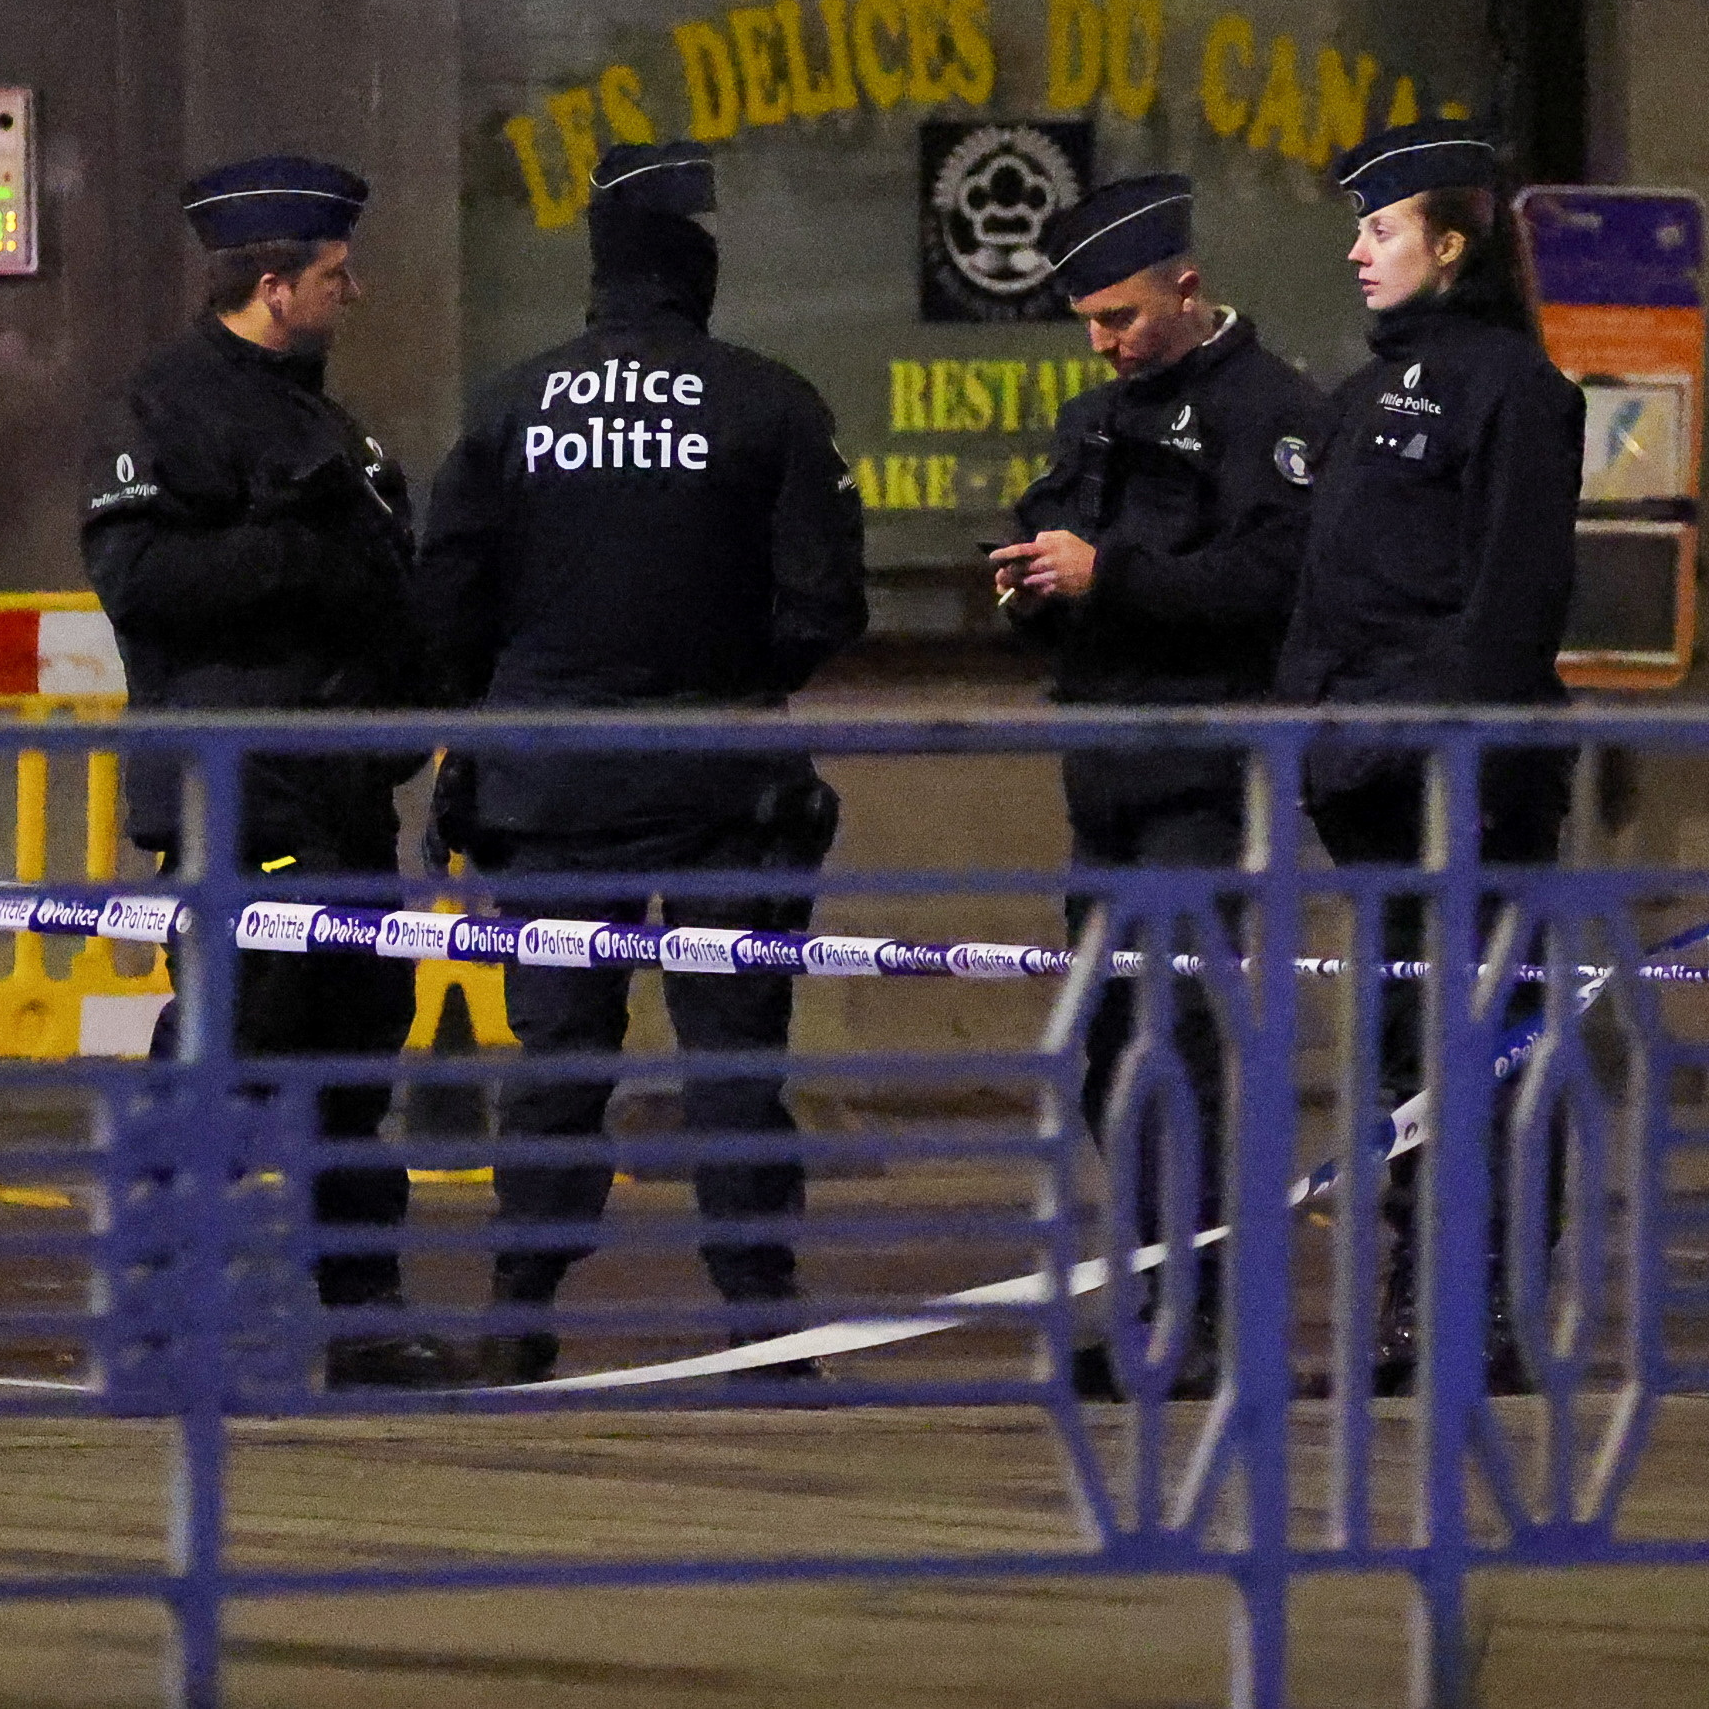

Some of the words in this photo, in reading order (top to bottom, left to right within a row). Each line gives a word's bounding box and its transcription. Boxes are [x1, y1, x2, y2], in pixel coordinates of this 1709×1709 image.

[526, 417, 709, 472] Politie
[50, 901, 99, 927] Police
[122, 904, 167, 931] Politie
[261, 912, 305, 940] Politie
[329, 918, 376, 945] Police
[401, 921, 444, 948] Politie
[471, 925, 516, 953] Police
[540, 929, 584, 956] Politie
[611, 931, 657, 960] Police
[682, 935, 728, 962] Politie
[753, 940, 800, 966] Police
